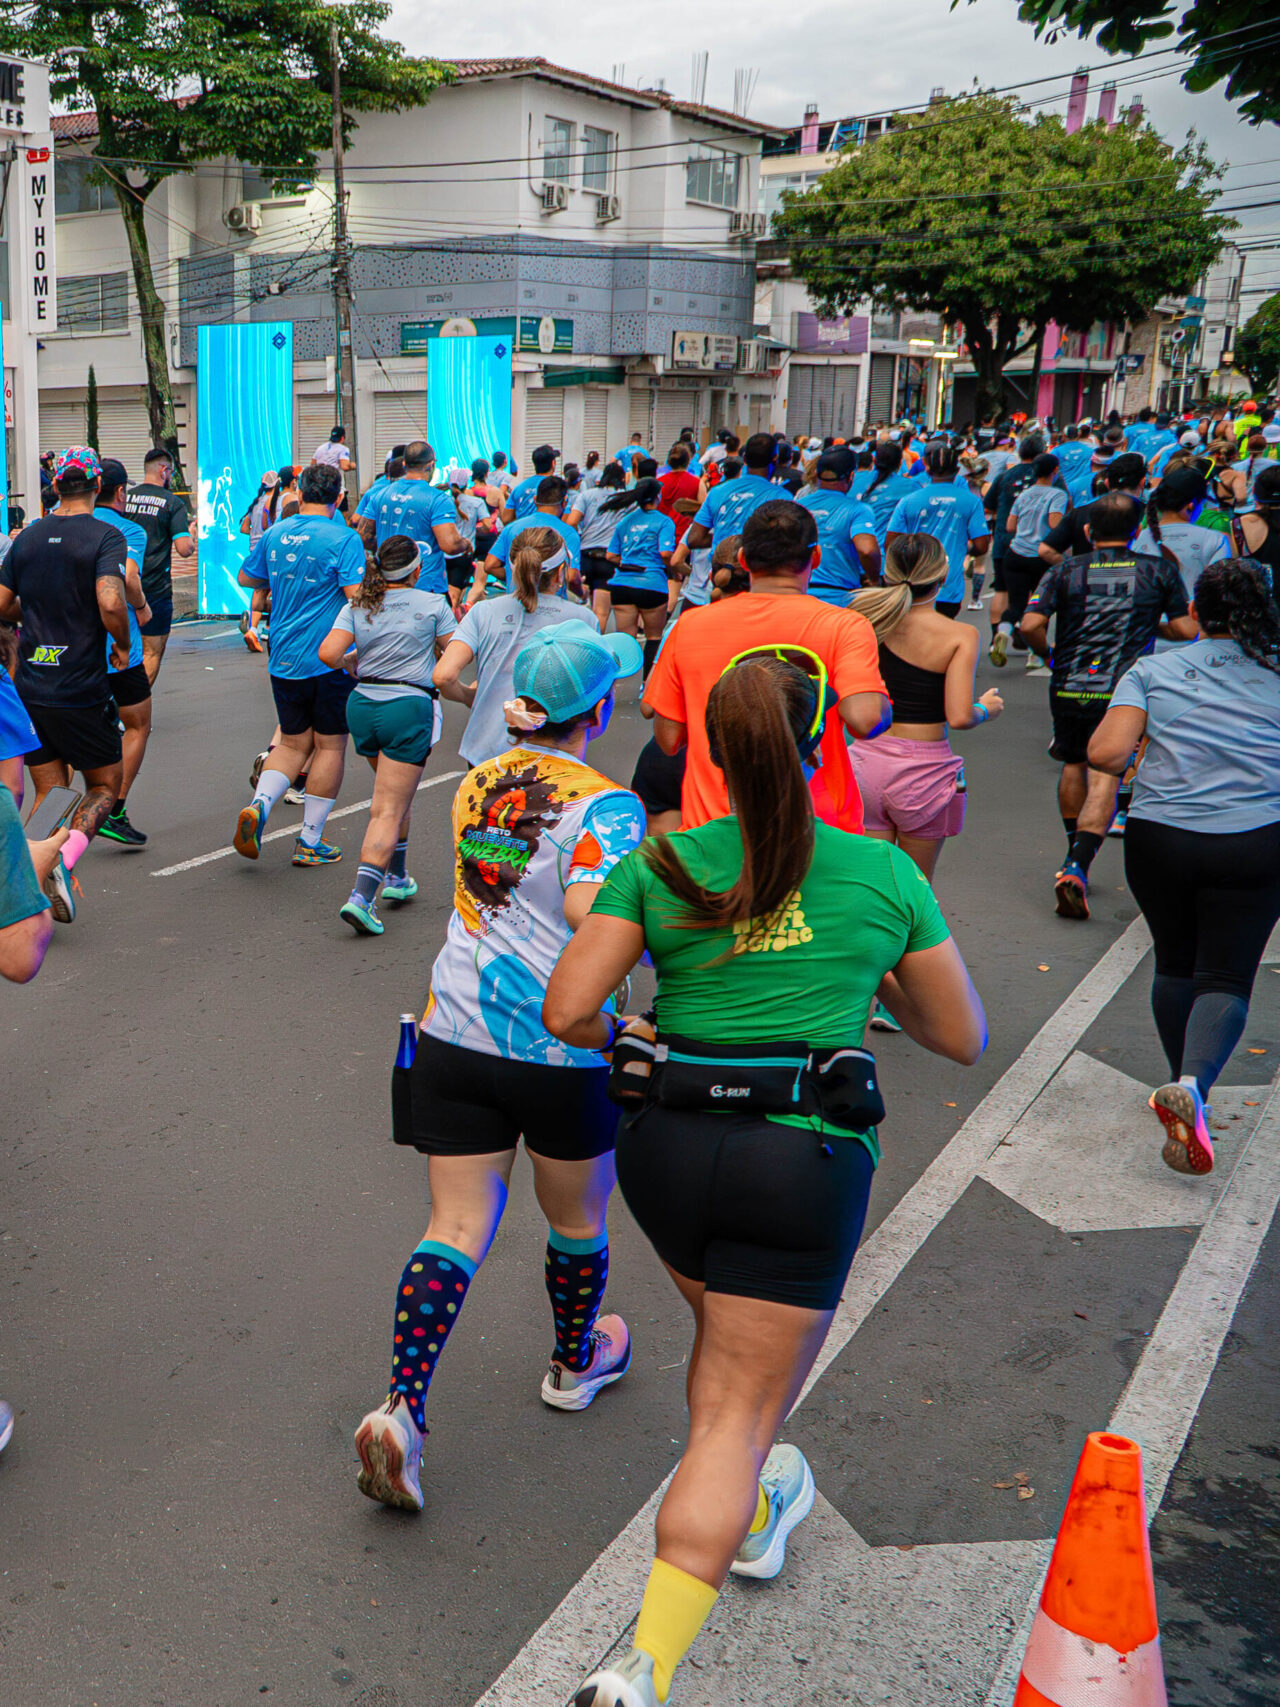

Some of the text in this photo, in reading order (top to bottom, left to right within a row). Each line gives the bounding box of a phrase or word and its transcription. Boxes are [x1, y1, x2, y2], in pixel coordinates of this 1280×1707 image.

[31, 175, 48, 320] MY HOME
[138, 505, 160, 516] CLUB
[486, 826, 512, 837] RETO
[466, 829, 528, 851] MUEVETE
